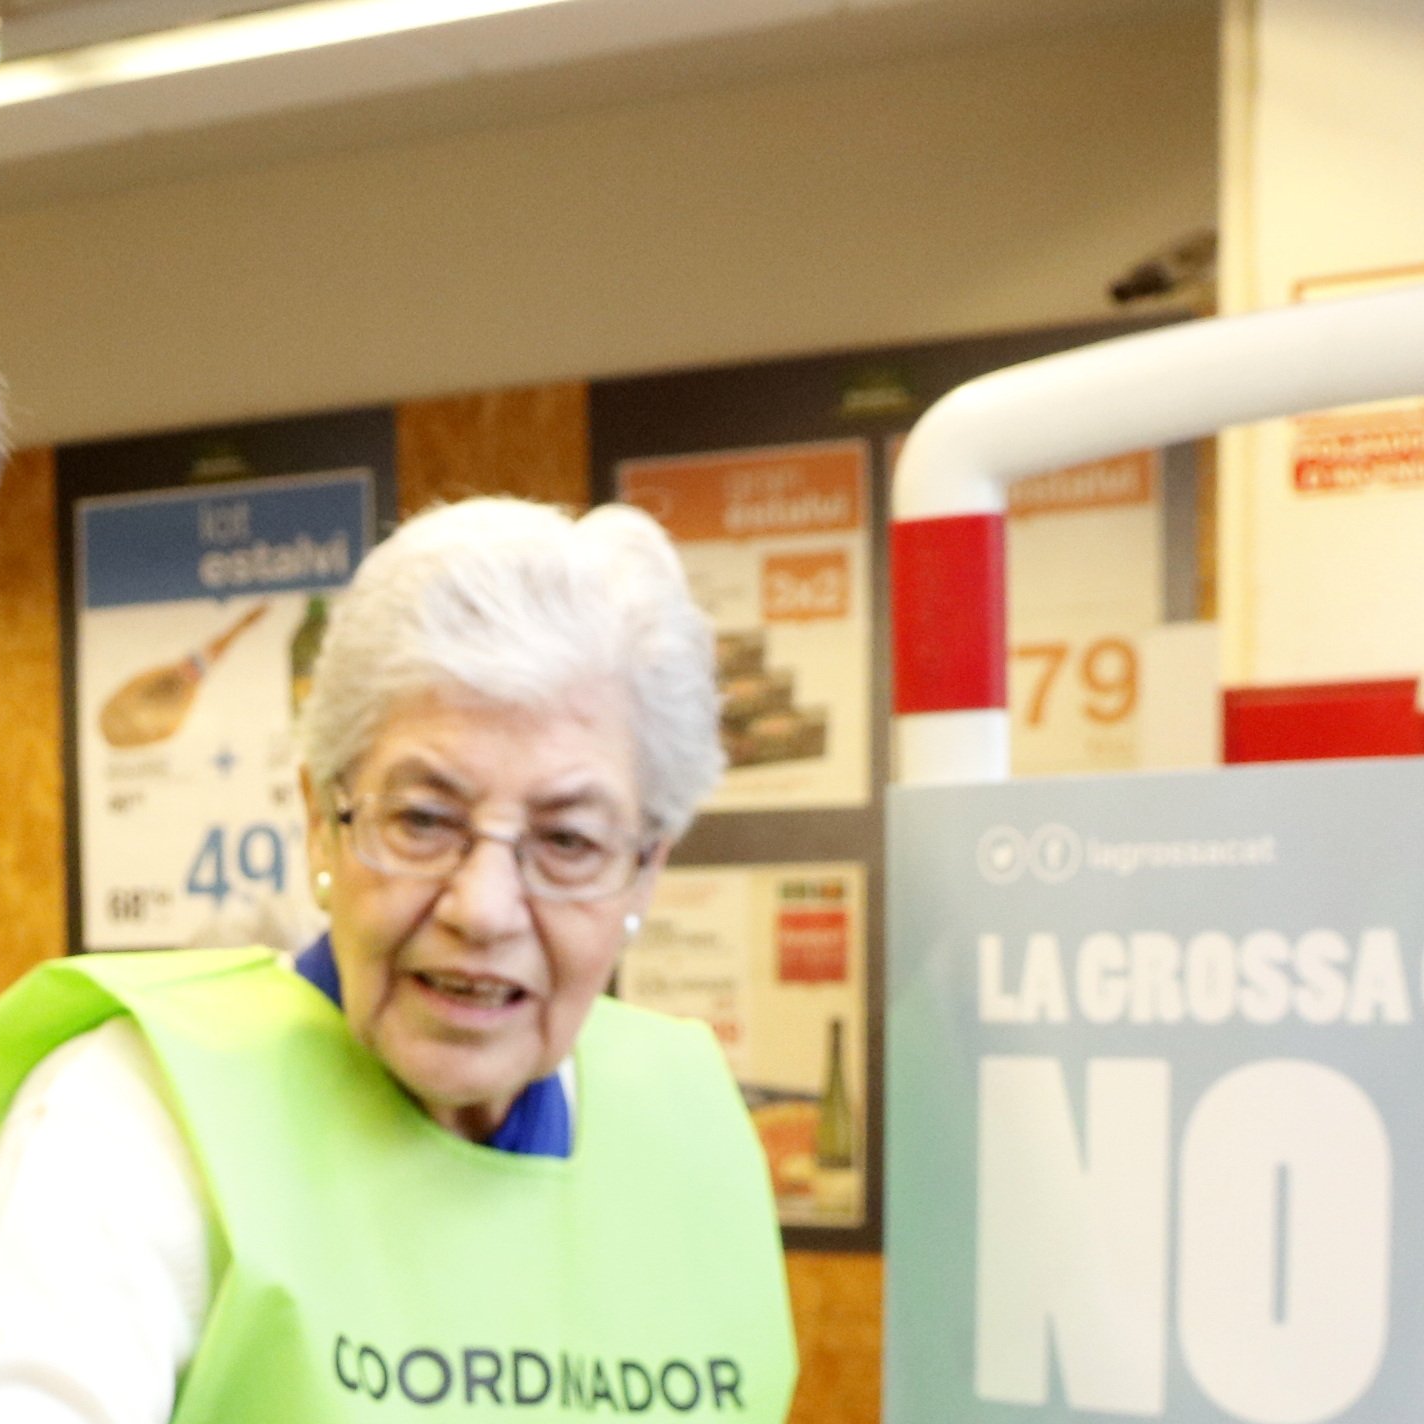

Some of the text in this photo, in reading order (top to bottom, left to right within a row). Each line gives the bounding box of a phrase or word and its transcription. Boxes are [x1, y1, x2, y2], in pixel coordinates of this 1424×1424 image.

[978, 926, 1412, 1024] LA GROSSA
[335, 1334, 746, 1412] COORDNADOR
